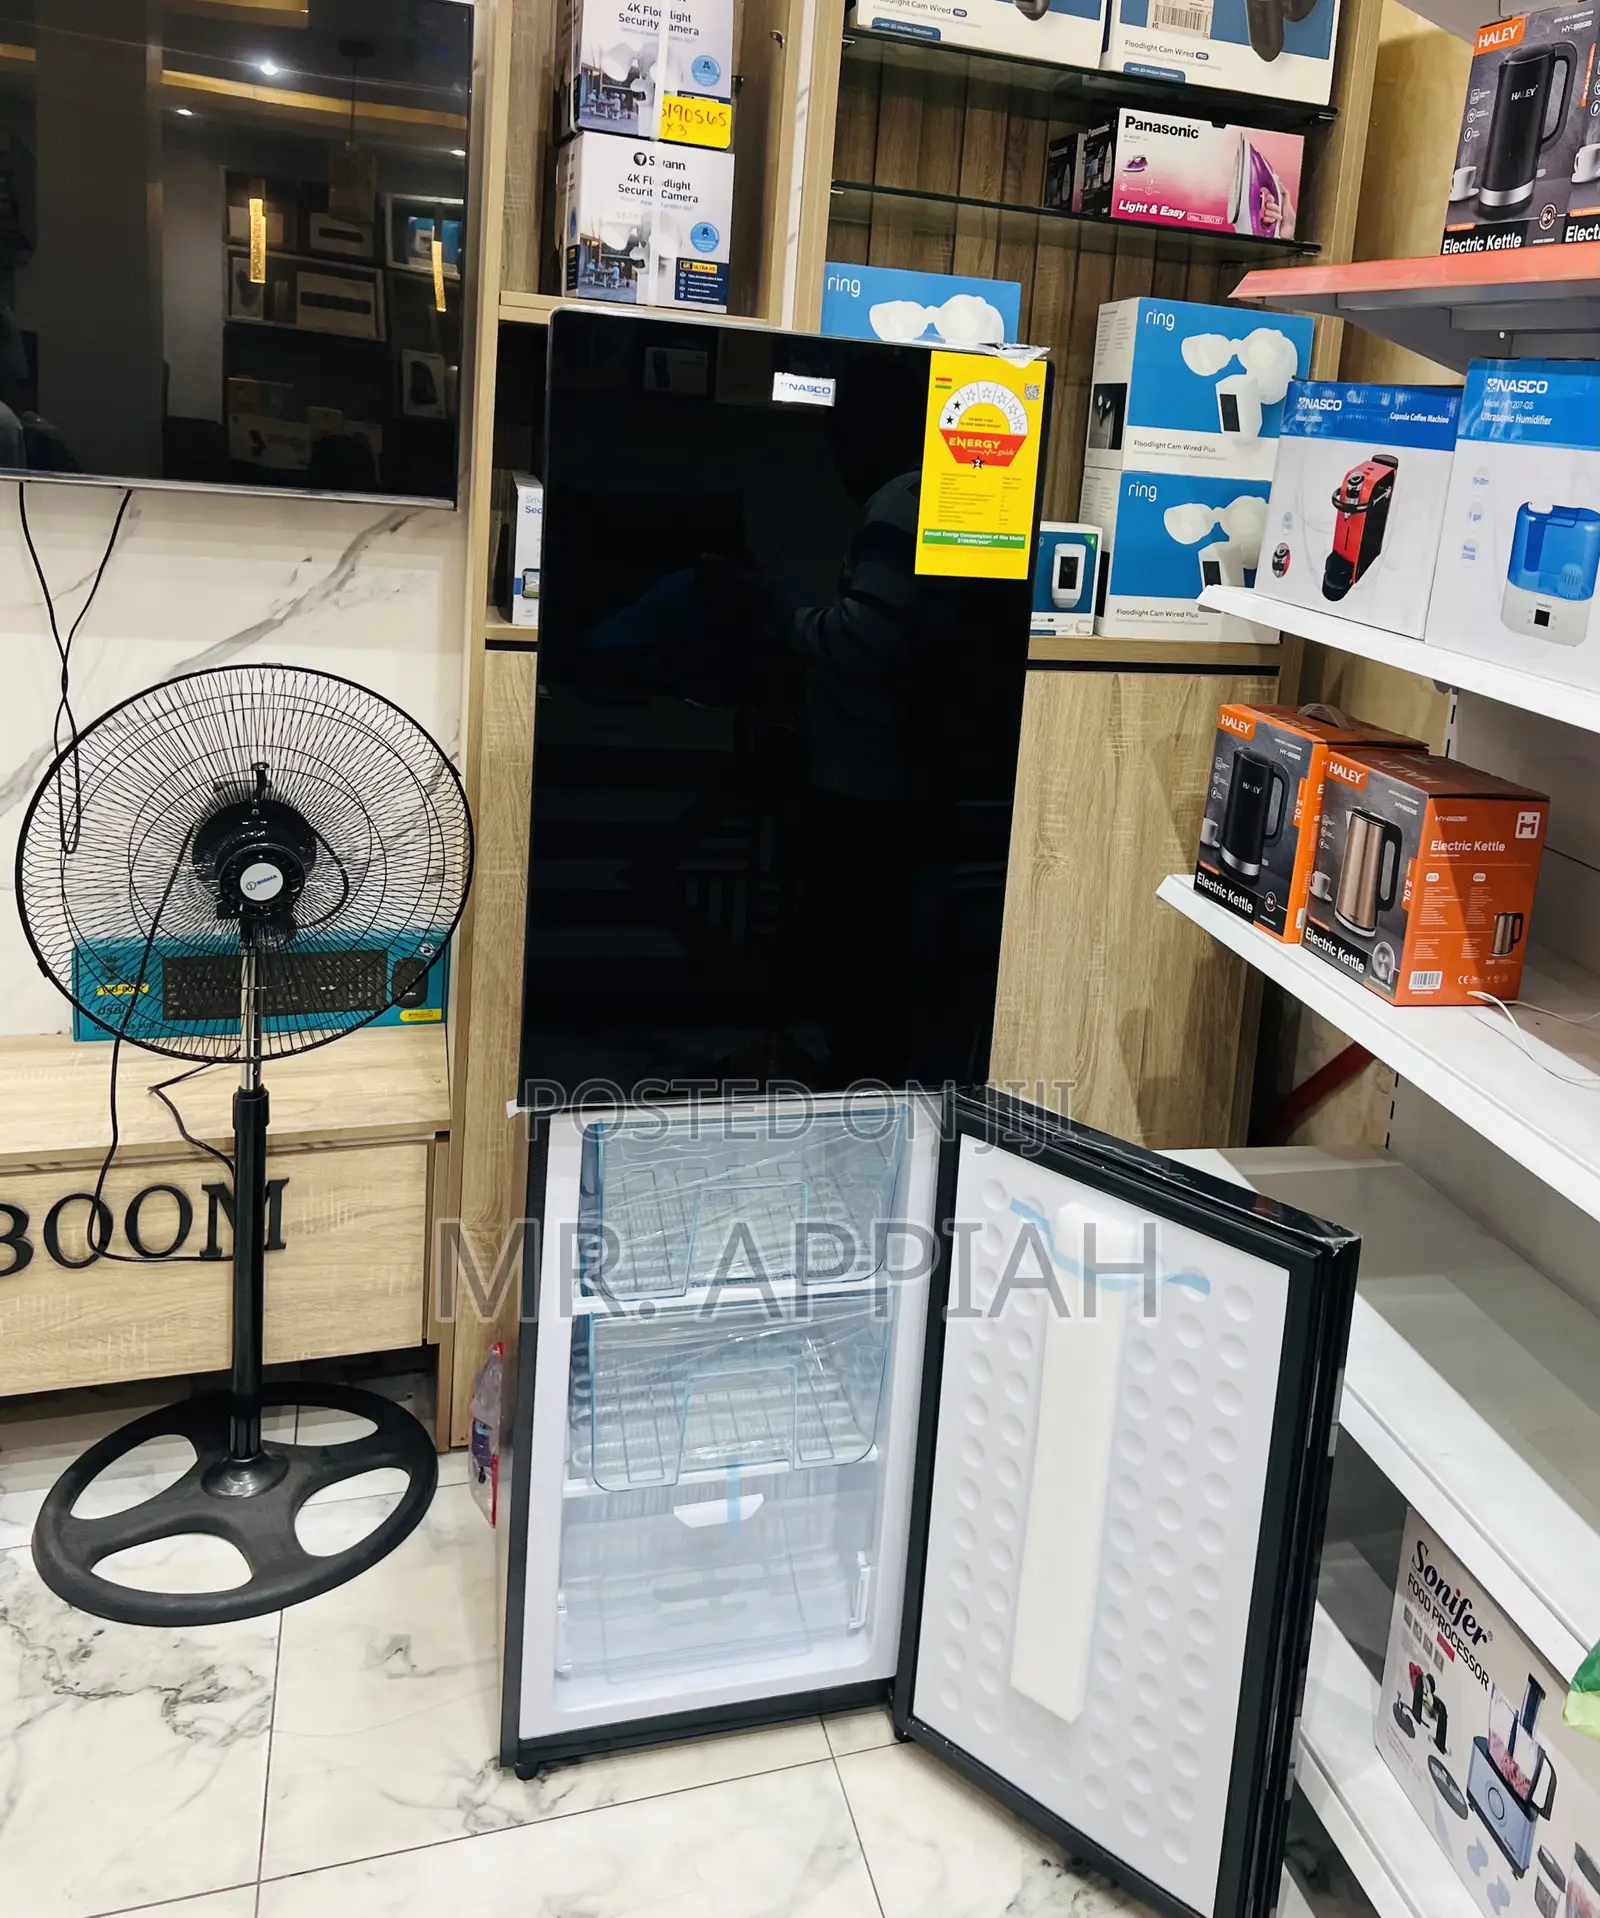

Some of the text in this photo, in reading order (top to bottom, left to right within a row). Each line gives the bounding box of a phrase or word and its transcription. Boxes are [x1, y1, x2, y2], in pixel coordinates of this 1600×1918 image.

[627, 2, 641, 13] 4K
[929, 3, 951, 14] Wired
[618, 12, 660, 31] Security
[667, 22, 700, 36] amera
[1478, 25, 1519, 49] HALEY
[1125, 39, 1158, 52] Floodlight
[1159, 45, 1174, 53] Cam
[1175, 48, 1195, 58] Wired
[1125, 115, 1200, 139] Panasonic
[648, 155, 686, 171] Sann
[627, 172, 691, 191] 4K Fldlight
[618, 184, 699, 203] Securit Camera
[1118, 199, 1148, 214] Light
[1149, 205, 1158, 215] &
[1159, 205, 1186, 219] Easy
[1442, 232, 1522, 254] Electric Kettle
[827, 273, 861, 298] ring
[1145, 308, 1176, 331] ring
[789, 382, 831, 395] NASCO
[1496, 379, 1548, 394] NASCO
[1304, 397, 1342, 411] NASCO
[1389, 411, 1449, 424] Capsule Coffee Machine
[1480, 411, 1552, 426] Ultrasonic Humidifier
[948, 436, 1001, 449] ENERGY
[1133, 440, 1166, 449] Floodlight
[1183, 444, 1202, 452] Wired
[1127, 481, 1158, 503] ring
[1116, 608, 1149, 617] Floodlight
[1221, 714, 1251, 734] HALEY
[1329, 761, 1362, 784] HALEY
[1242, 781, 1261, 795] HAEY
[1293, 800, 1304, 821] 2.0L
[1430, 839, 1506, 852] Electric Kettle
[1196, 871, 1253, 914] Electric Kettle
[1403, 879, 1413, 902] 2.0L
[1305, 926, 1365, 974] Electric Kettle
[1411, 1539, 1488, 1646] Sonifer
[1407, 1572, 1489, 1692] FOOD PROCESSOR
